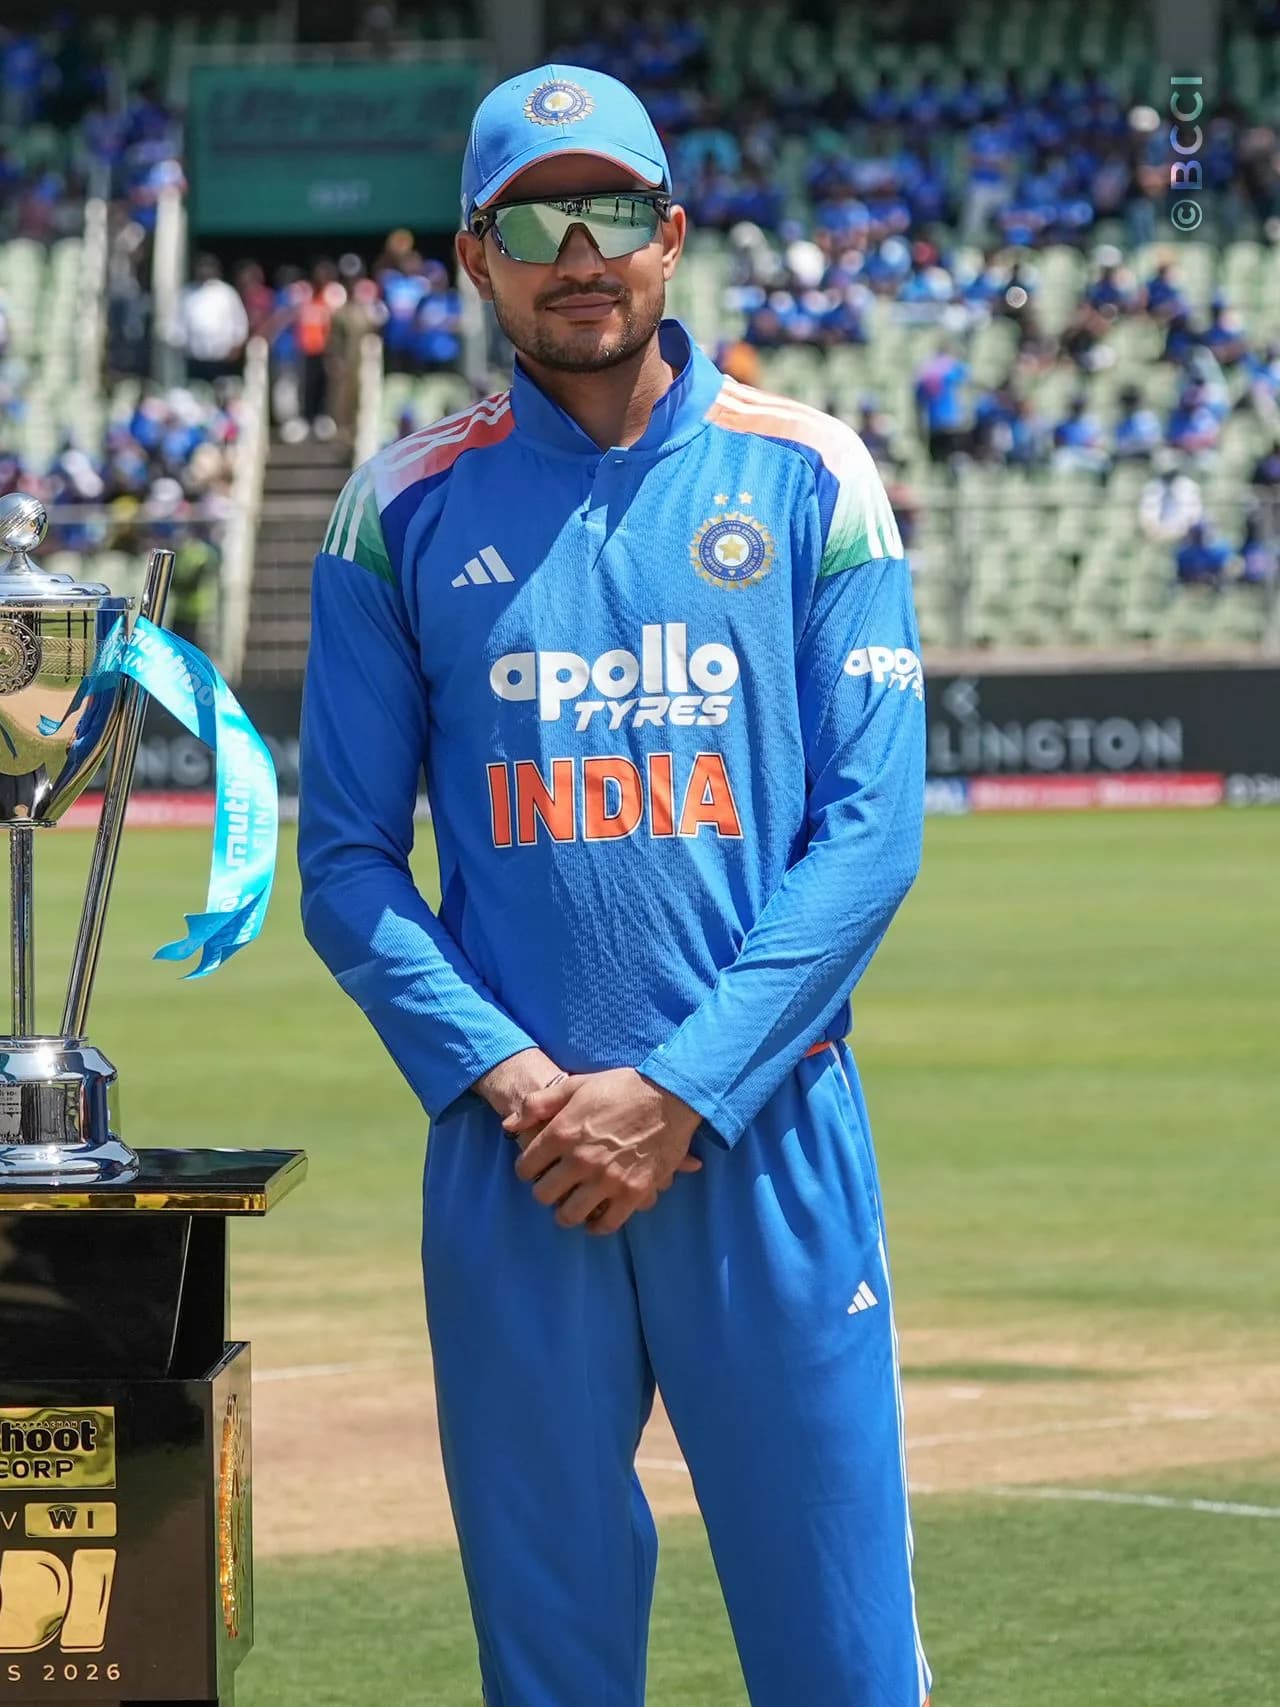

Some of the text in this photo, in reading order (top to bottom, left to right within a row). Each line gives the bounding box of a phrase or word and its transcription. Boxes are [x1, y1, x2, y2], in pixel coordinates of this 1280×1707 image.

[490, 623, 739, 721] apollo
[843, 646, 921, 683] apo
[575, 695, 733, 731] TYRES
[486, 752, 744, 848] INDIA
[47, 1510, 95, 1530] WI
[43, 1664, 121, 1682] 2026
